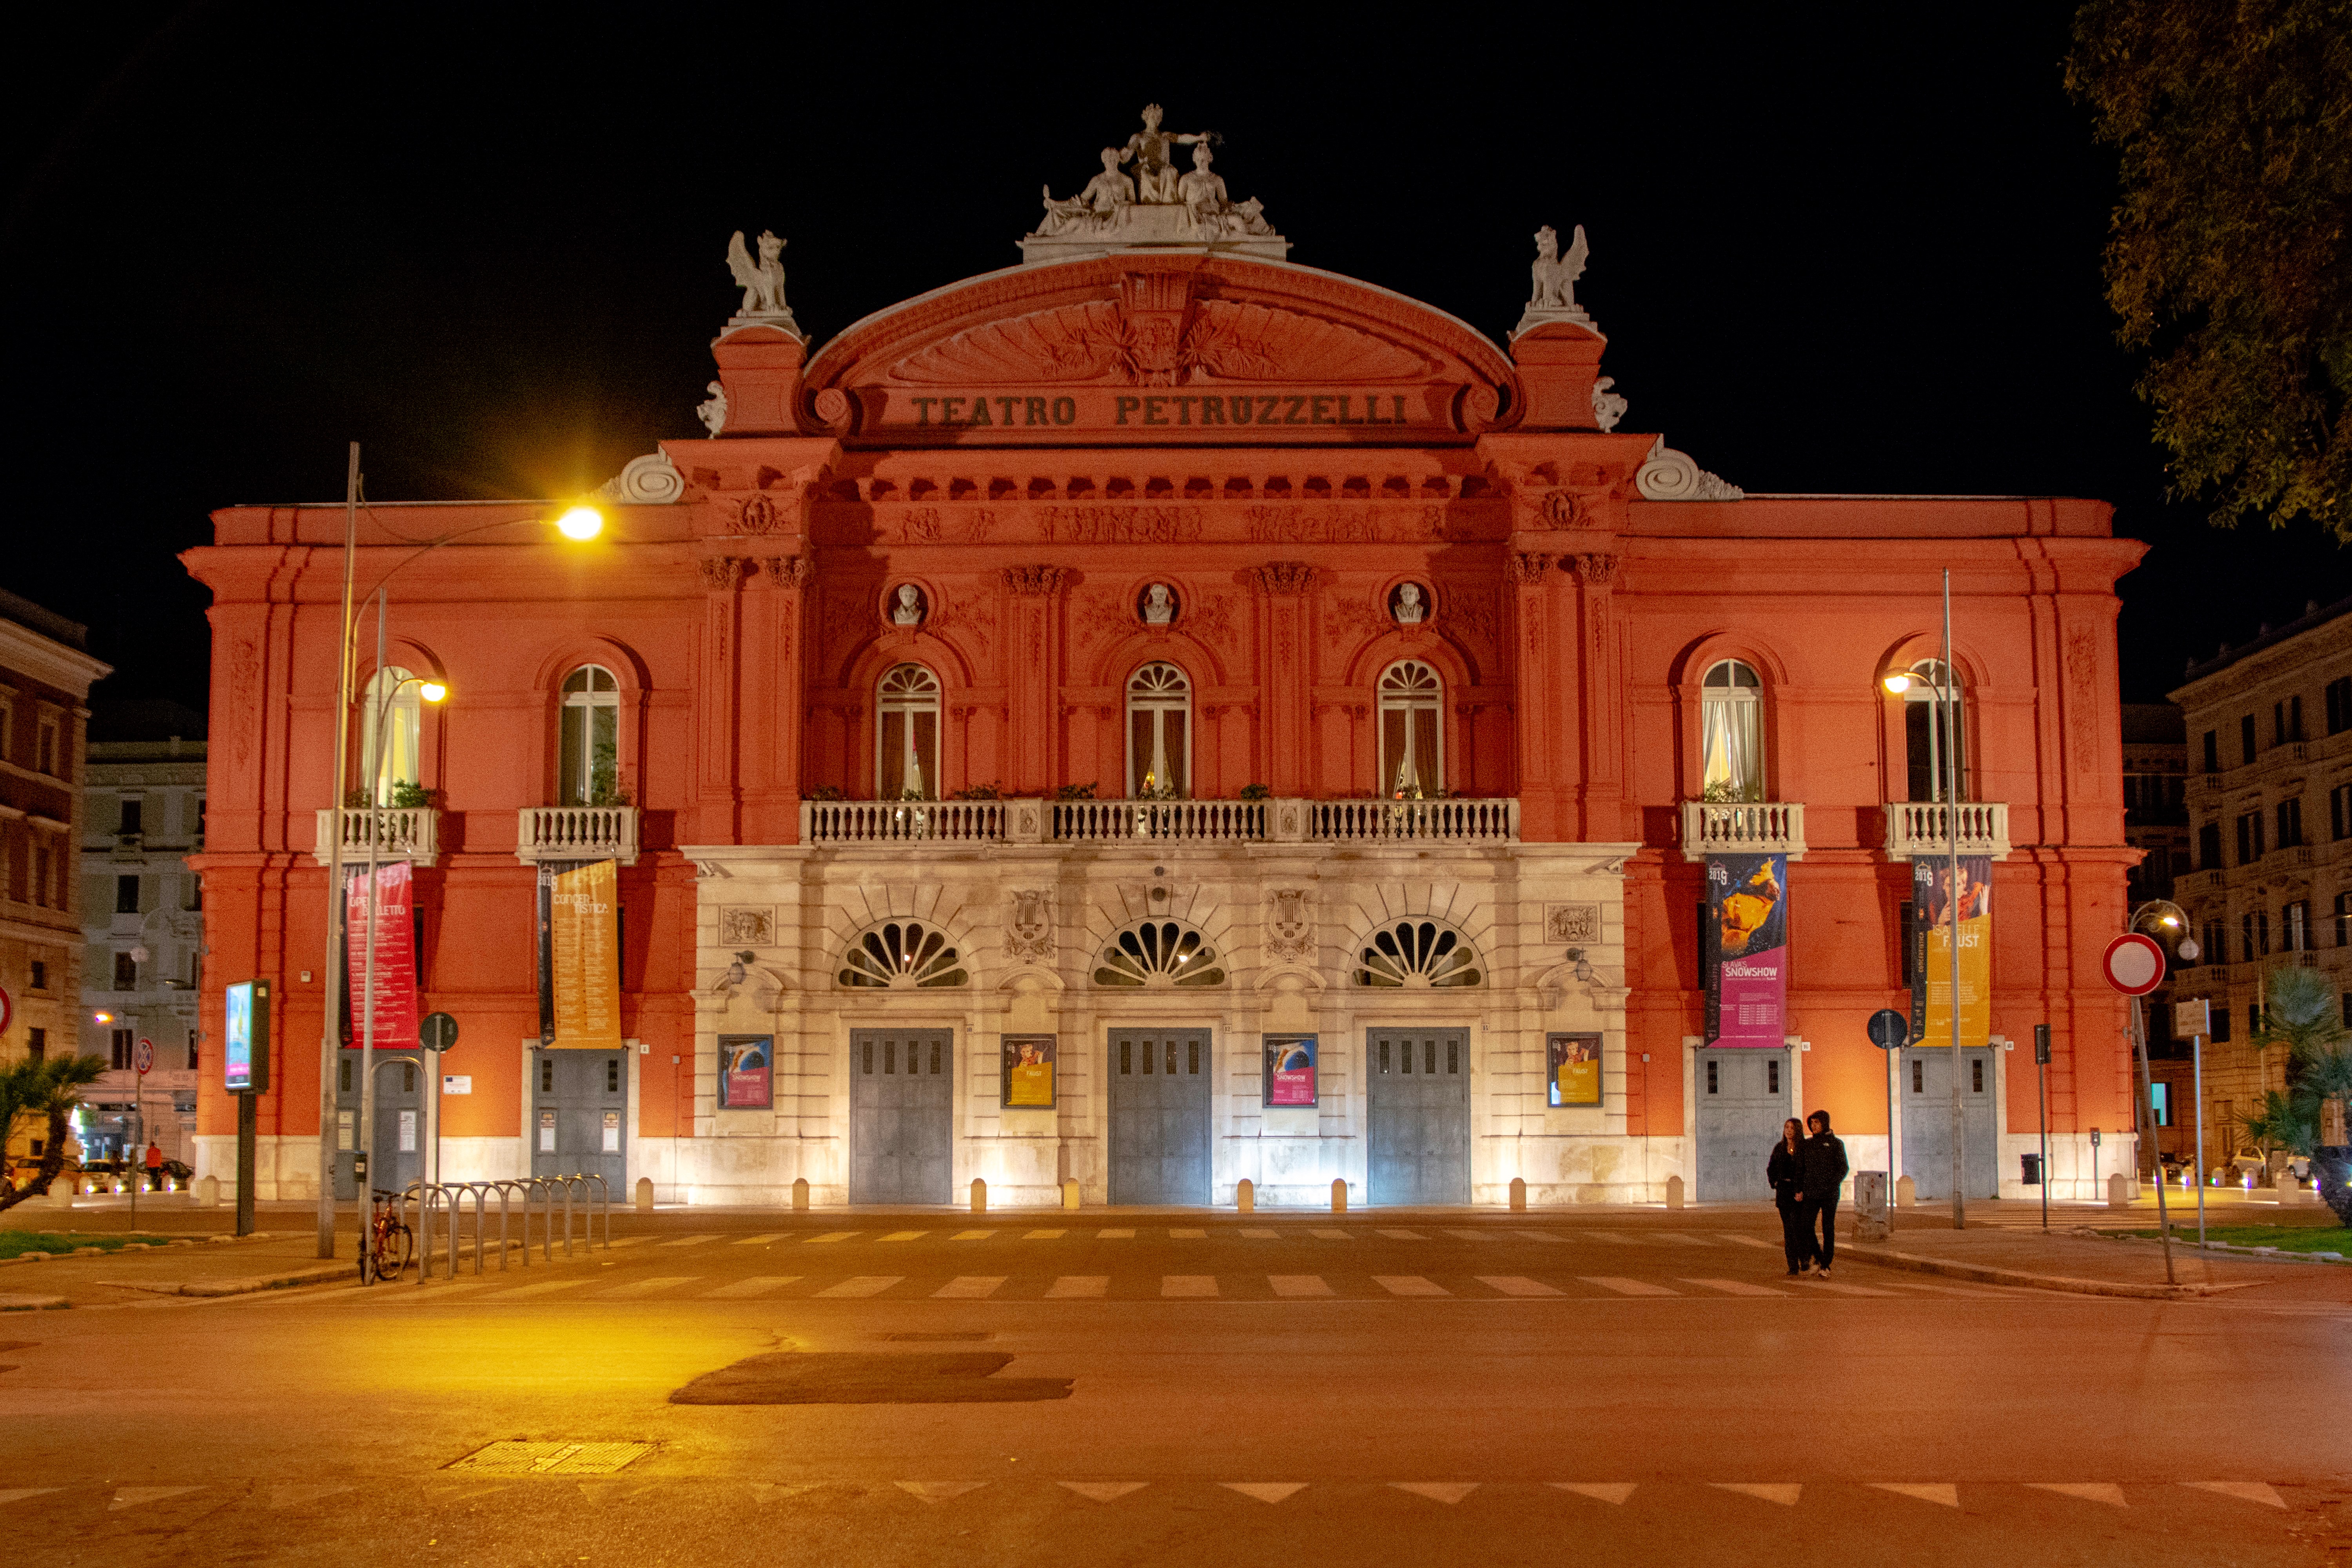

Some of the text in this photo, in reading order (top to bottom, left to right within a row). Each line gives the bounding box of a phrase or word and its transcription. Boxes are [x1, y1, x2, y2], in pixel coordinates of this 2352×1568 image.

[911, 395, 1407, 426] TEATRO PETRUZZELLI
[1709, 870, 1727, 885] 2019
[1915, 871, 1933, 886] 2019
[363, 904, 405, 916] BLLETTO
[1933, 925, 1979, 935] ISAELLE
[1943, 935, 1979, 948] FUST
[1726, 967, 1777, 977] SNOWSHOW
